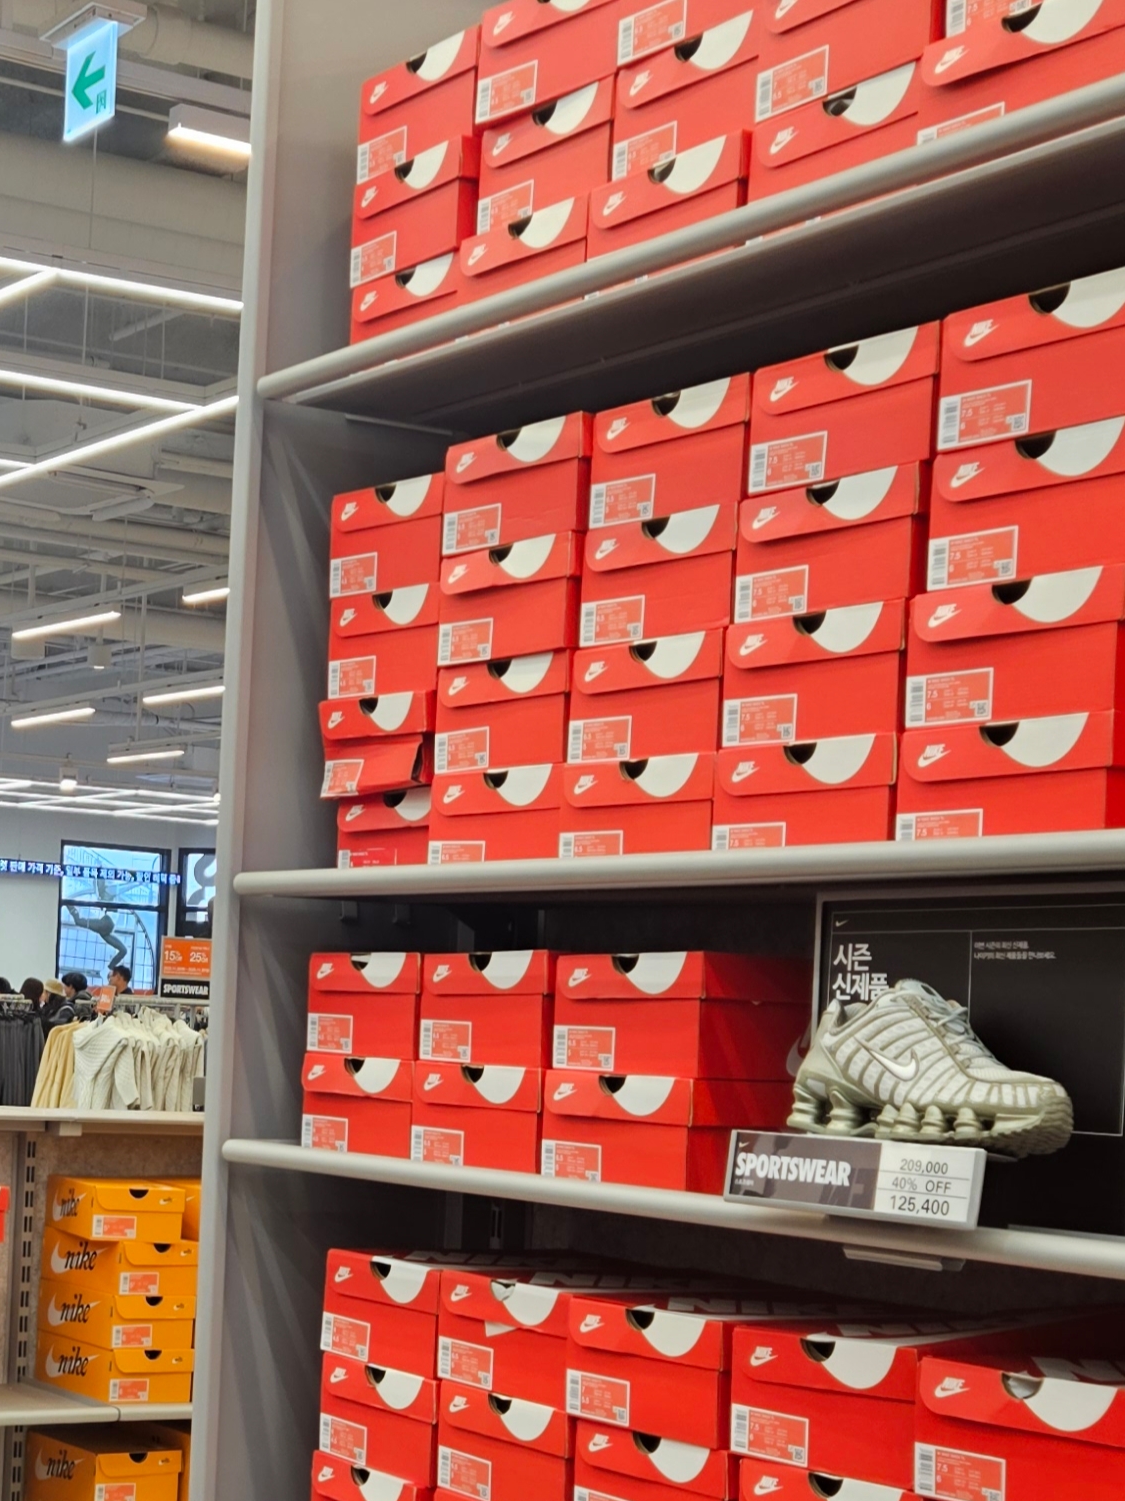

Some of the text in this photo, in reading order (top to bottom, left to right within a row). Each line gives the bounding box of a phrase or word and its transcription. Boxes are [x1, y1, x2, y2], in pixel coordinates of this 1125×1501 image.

[833, 943, 872, 972] 시즌
[163, 983, 209, 995] SPORTSWEAR
[832, 972, 890, 1001] 신제품
[735, 1151, 852, 1187] SPORTSWEAR
[900, 1158, 948, 1175] 209,000
[892, 1176, 952, 1194] 40% OFF
[889, 1195, 950, 1216] 125,400
[64, 1241, 98, 1271] nike
[60, 1294, 91, 1323] nike
[58, 1346, 89, 1377] nike
[46, 1449, 75, 1480] nike
